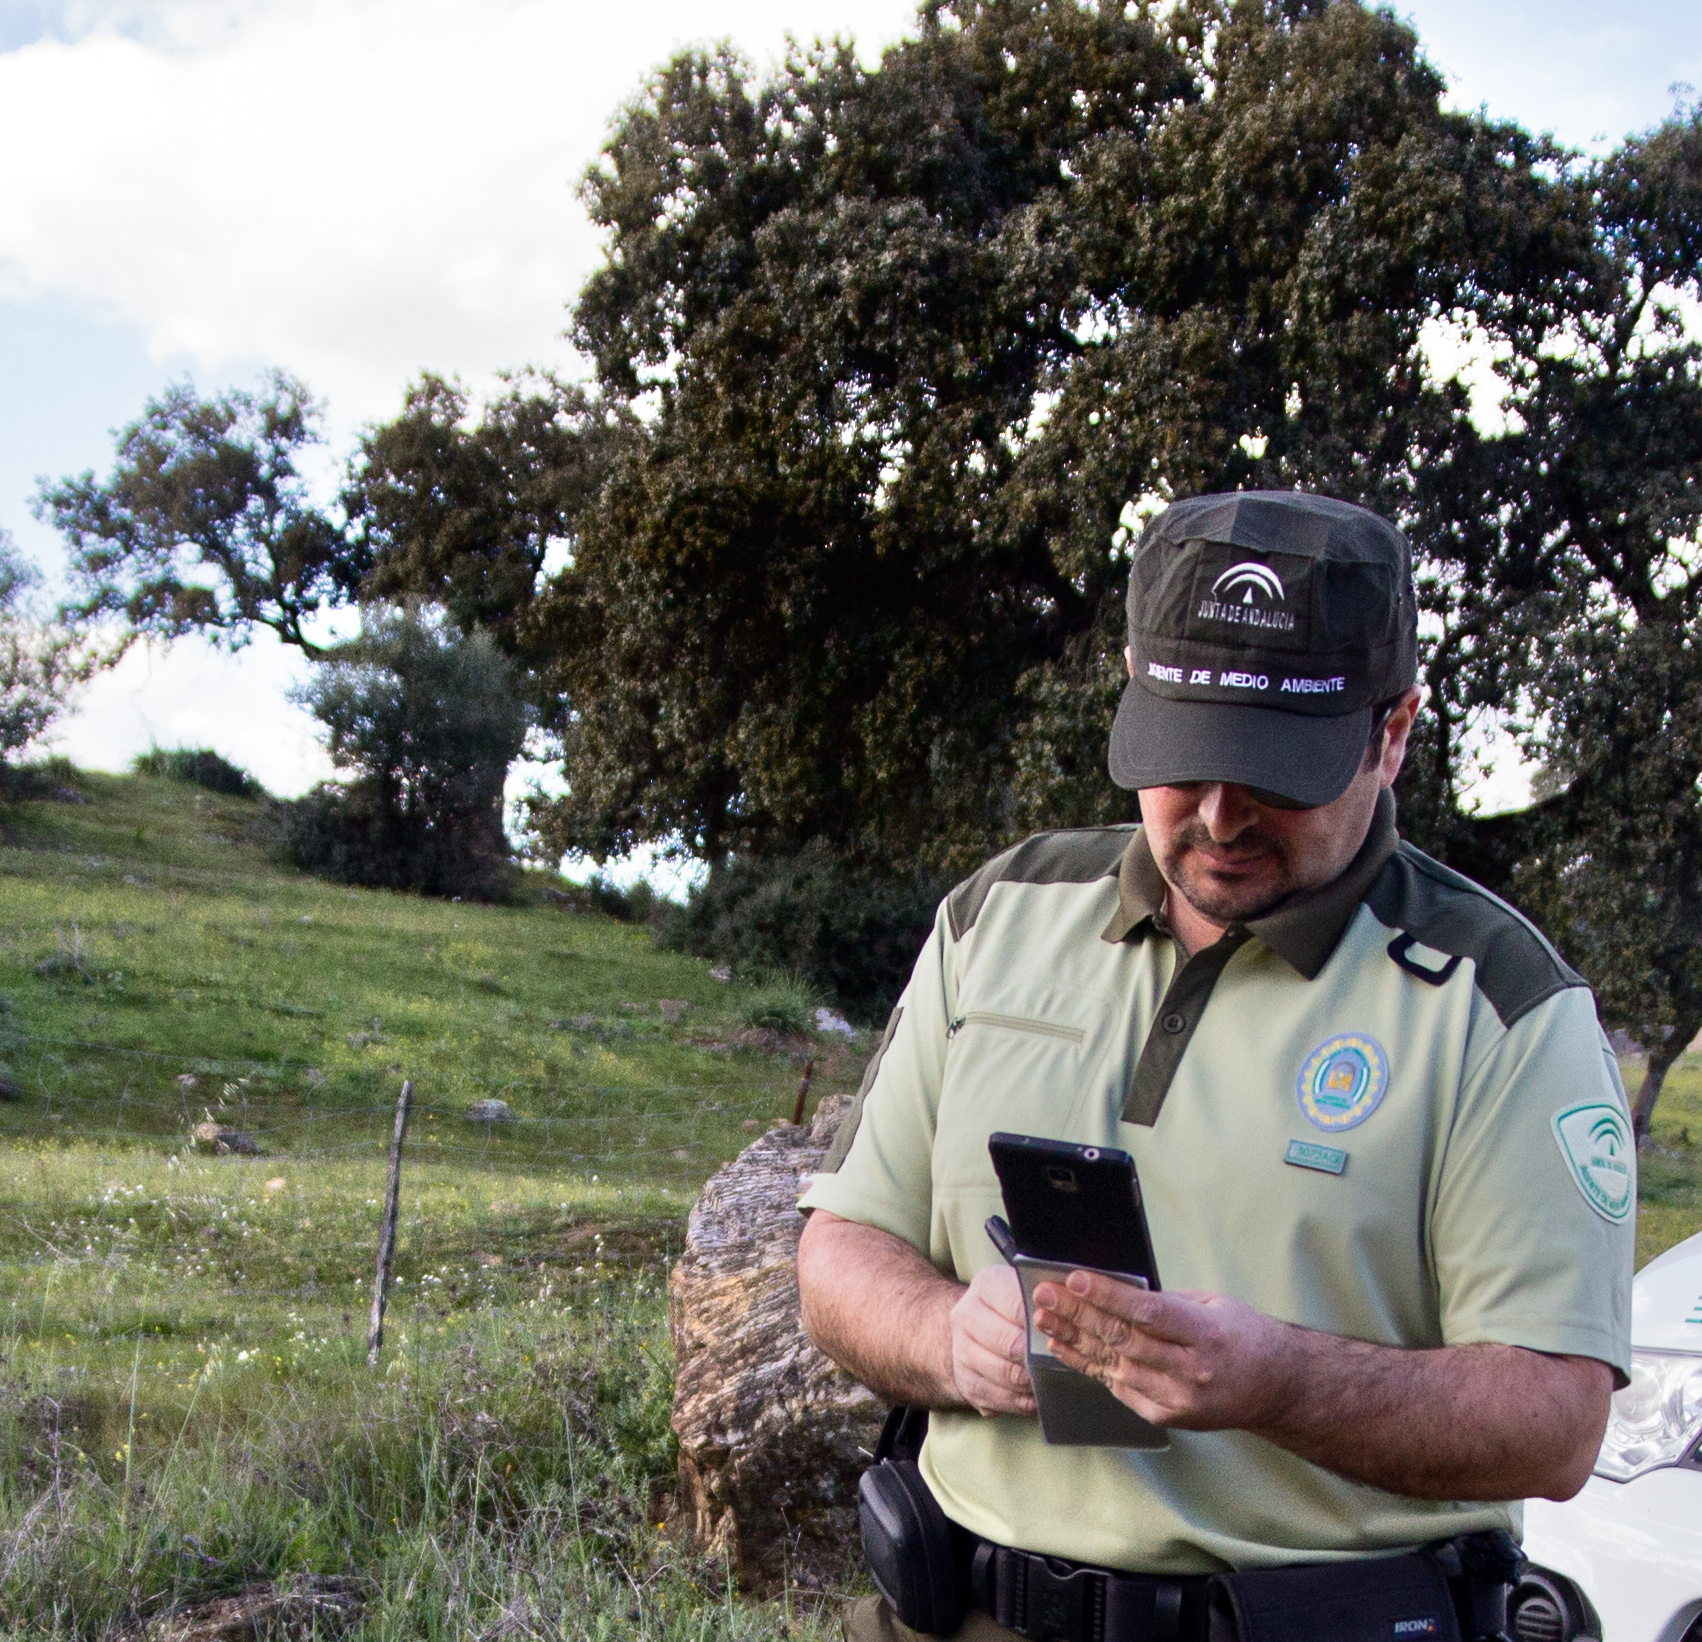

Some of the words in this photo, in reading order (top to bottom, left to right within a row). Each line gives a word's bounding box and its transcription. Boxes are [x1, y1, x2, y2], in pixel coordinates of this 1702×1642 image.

[1189, 669, 1212, 685] DE
[1219, 671, 1269, 690] MEDIO
[1280, 676, 1346, 694] AMBIENTE
